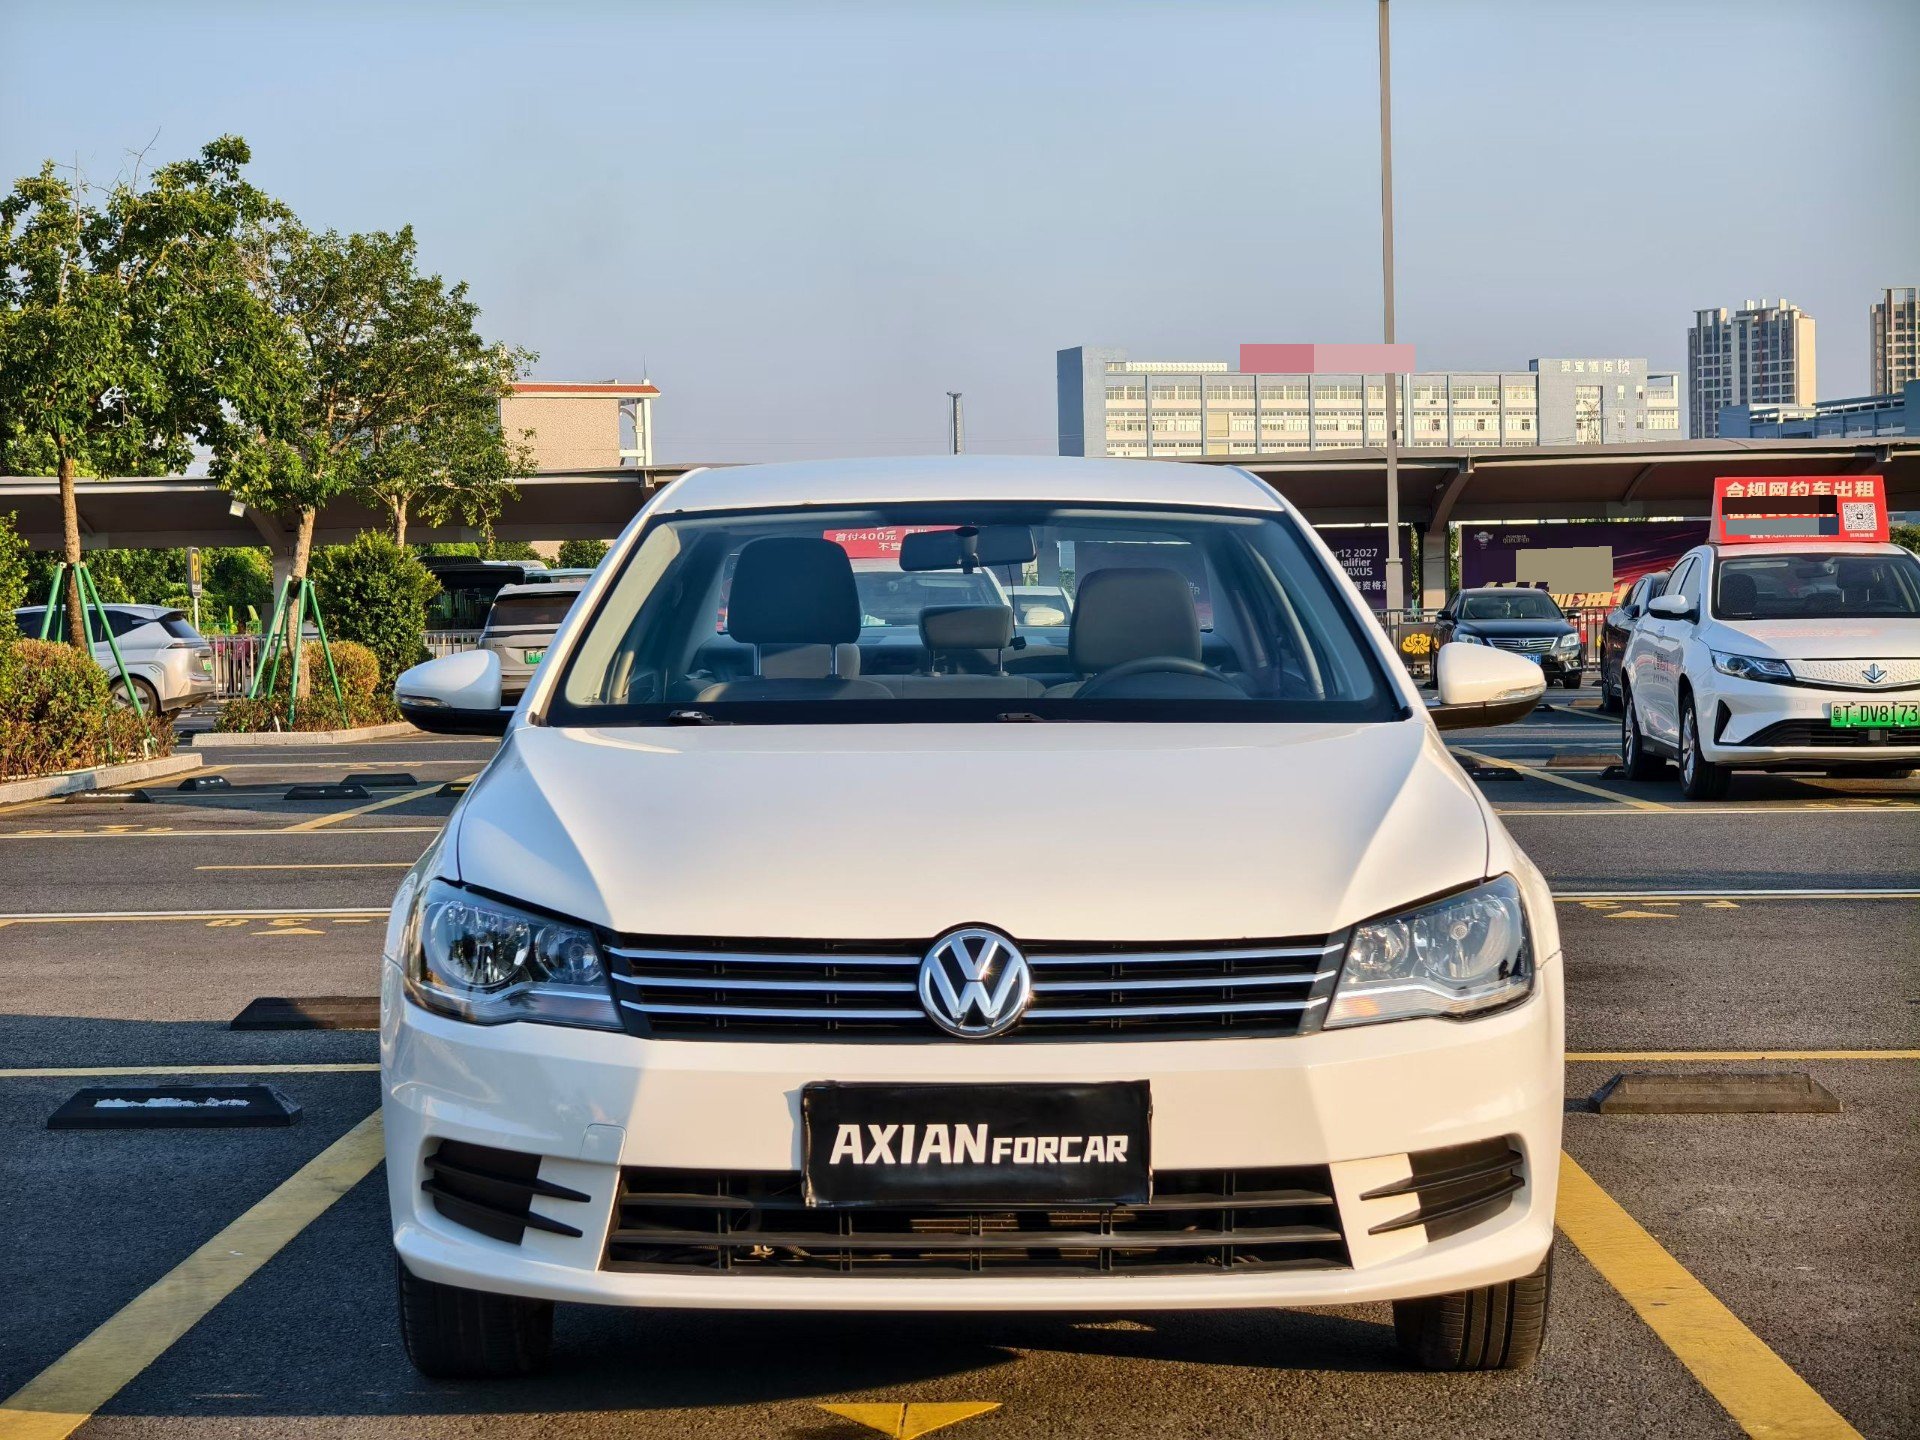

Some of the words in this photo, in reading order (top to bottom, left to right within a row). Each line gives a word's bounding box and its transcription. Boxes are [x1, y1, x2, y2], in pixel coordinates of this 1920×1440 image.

[1725, 481, 1874, 497] 合规网约车出租
[1353, 548, 1378, 557] 2027
[829, 1123, 988, 1165] AXIAN
[991, 1135, 1128, 1164] FORCAR
